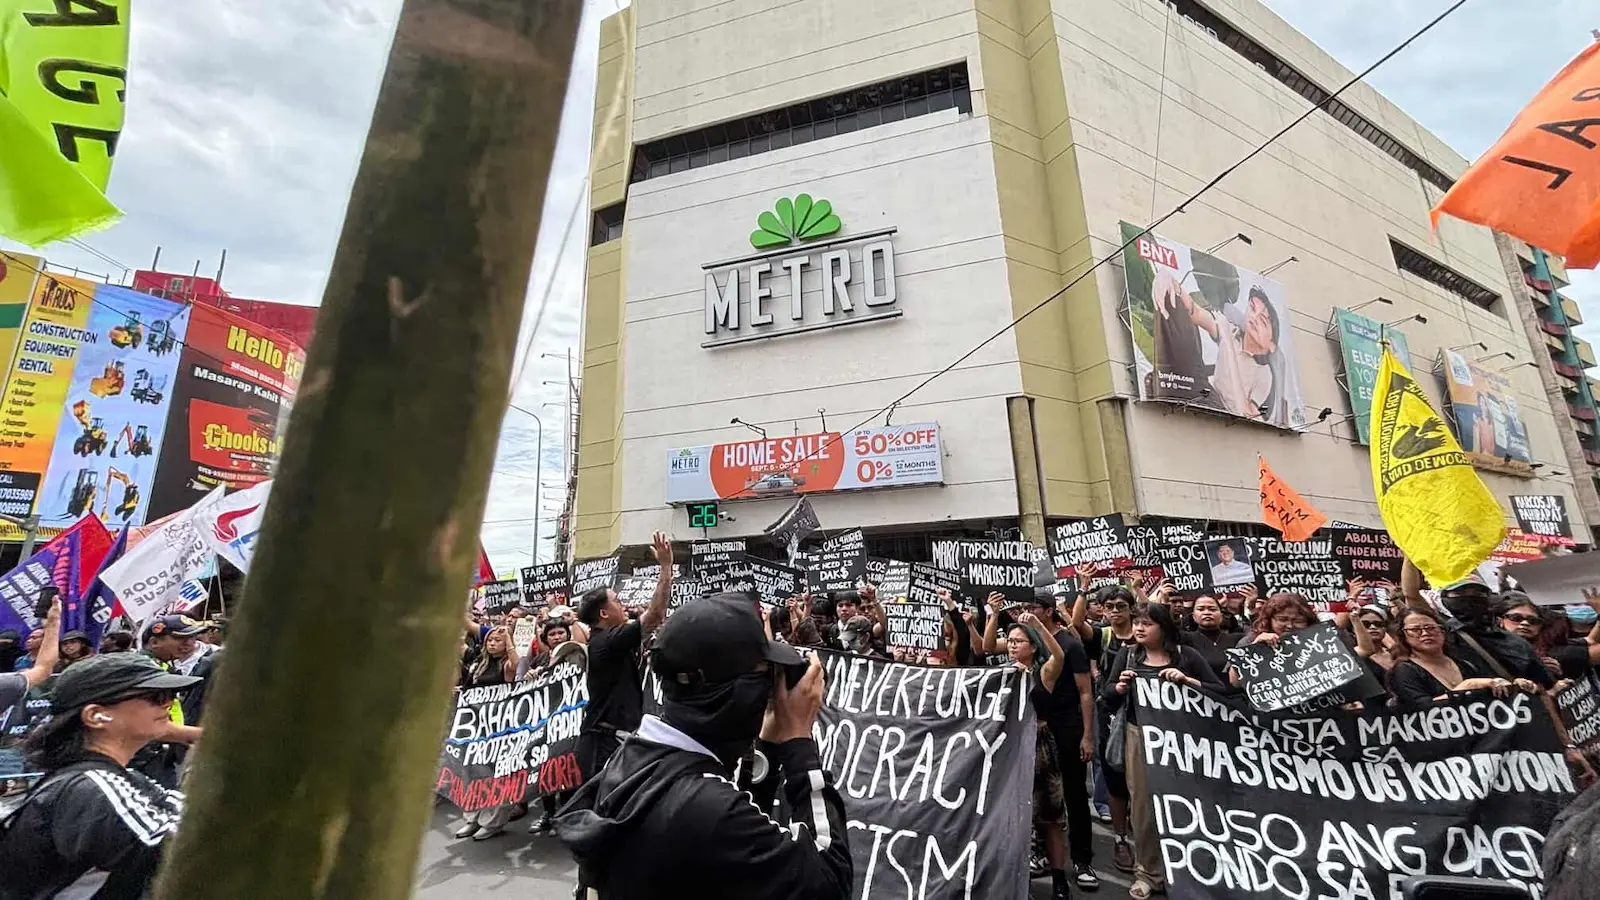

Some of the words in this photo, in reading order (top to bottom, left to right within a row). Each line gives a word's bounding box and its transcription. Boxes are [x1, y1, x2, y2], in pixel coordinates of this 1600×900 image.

[1139, 240, 1177, 266] BNY
[703, 239, 898, 335] METRO
[29, 321, 99, 344] CONSTRUCTION
[24, 339, 77, 358] EQUIPMENT
[227, 325, 283, 369] Hello
[18, 358, 53, 374] RENTAL
[194, 366, 252, 393] Masarap
[254, 385, 279, 404] Kahit
[202, 423, 268, 454] Chooks
[854, 433, 901, 456] 50%
[903, 429, 936, 446] OFF
[723, 441, 777, 468] HOME
[781, 435, 830, 463] SALE
[671, 458, 700, 470] METRO
[856, 460, 892, 483] 0%
[904, 460, 936, 469] MONTHS
[692, 504, 716, 528] 26
[1056, 519, 1088, 539] PONDO
[1093, 516, 1110, 531] SA
[960, 540, 1034, 562] TOPSNATCHER
[1054, 527, 1118, 553] LABORATORIES
[1335, 545, 1378, 558] GENDER
[823, 551, 841, 561] ONLY
[1159, 547, 1178, 559] THE
[1178, 544, 1206, 562] OG
[523, 566, 545, 579] FAIR
[546, 562, 565, 574] PAY
[1163, 560, 1193, 578] NEPO
[1254, 560, 1341, 575] NORMALITES
[1351, 559, 1390, 571] FORMS
[523, 581, 544, 594] FAIR
[543, 576, 567, 590] WORK
[1174, 573, 1204, 591] BABY
[1263, 573, 1304, 588] FIGHT
[888, 618, 908, 632] FIGHT
[908, 618, 944, 636] AGAINST
[889, 632, 938, 650] CORRUPTION
[1286, 663, 1322, 684] BUDGET
[1323, 657, 1342, 670] FOR
[826, 653, 924, 721] NEVER
[917, 666, 1029, 722] FORGET
[1251, 689, 1282, 704] FLOOD
[450, 686, 550, 740] BAHAON
[558, 671, 591, 710] NA
[1134, 675, 1346, 747] NORMALISTA
[1238, 725, 1337, 760] BATOK
[1360, 746, 1406, 764] SA
[529, 744, 549, 769] SA
[1142, 724, 1356, 801] PAMASISMO
[1352, 760, 1408, 803] UG
[1152, 794, 1308, 858] IDUSO
[1316, 819, 1427, 876] ANG
[1159, 837, 1311, 900] PONDO
